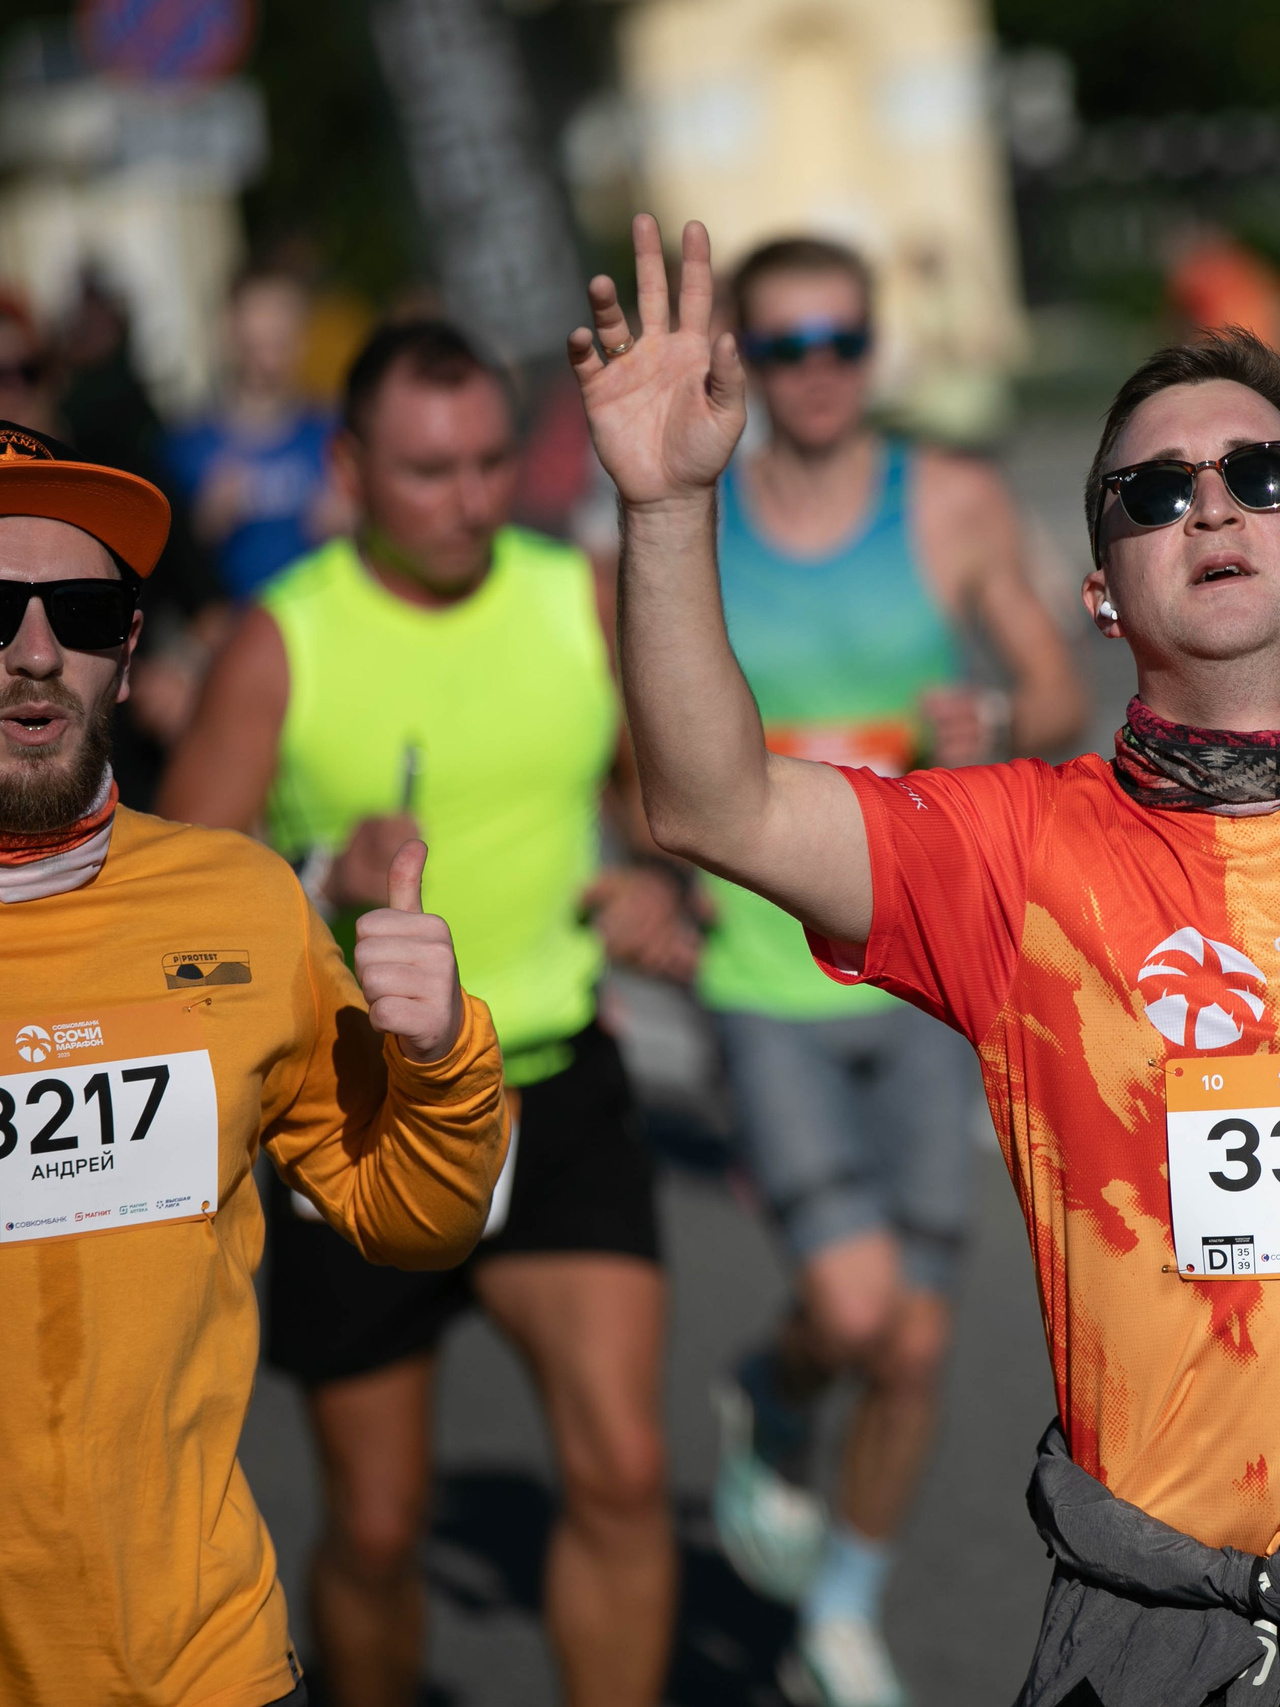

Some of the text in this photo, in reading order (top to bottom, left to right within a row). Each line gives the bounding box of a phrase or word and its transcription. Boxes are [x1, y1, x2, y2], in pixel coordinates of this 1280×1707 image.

[181, 953, 218, 962] PROTEST
[52, 1020, 99, 1031] СОВКОМБАНК
[54, 1027, 102, 1044] СОЧИ
[55, 1039, 104, 1051] МАРАФОН
[1201, 1074, 1224, 1091] 10
[31, 1150, 115, 1181] АНДРЕЙ
[15, 1209, 111, 1229] СОВКОМБАНК МАГНИТ
[1208, 1249, 1228, 1270] D
[1237, 1248, 1250, 1257] 35
[1238, 1261, 1251, 1270] 39
